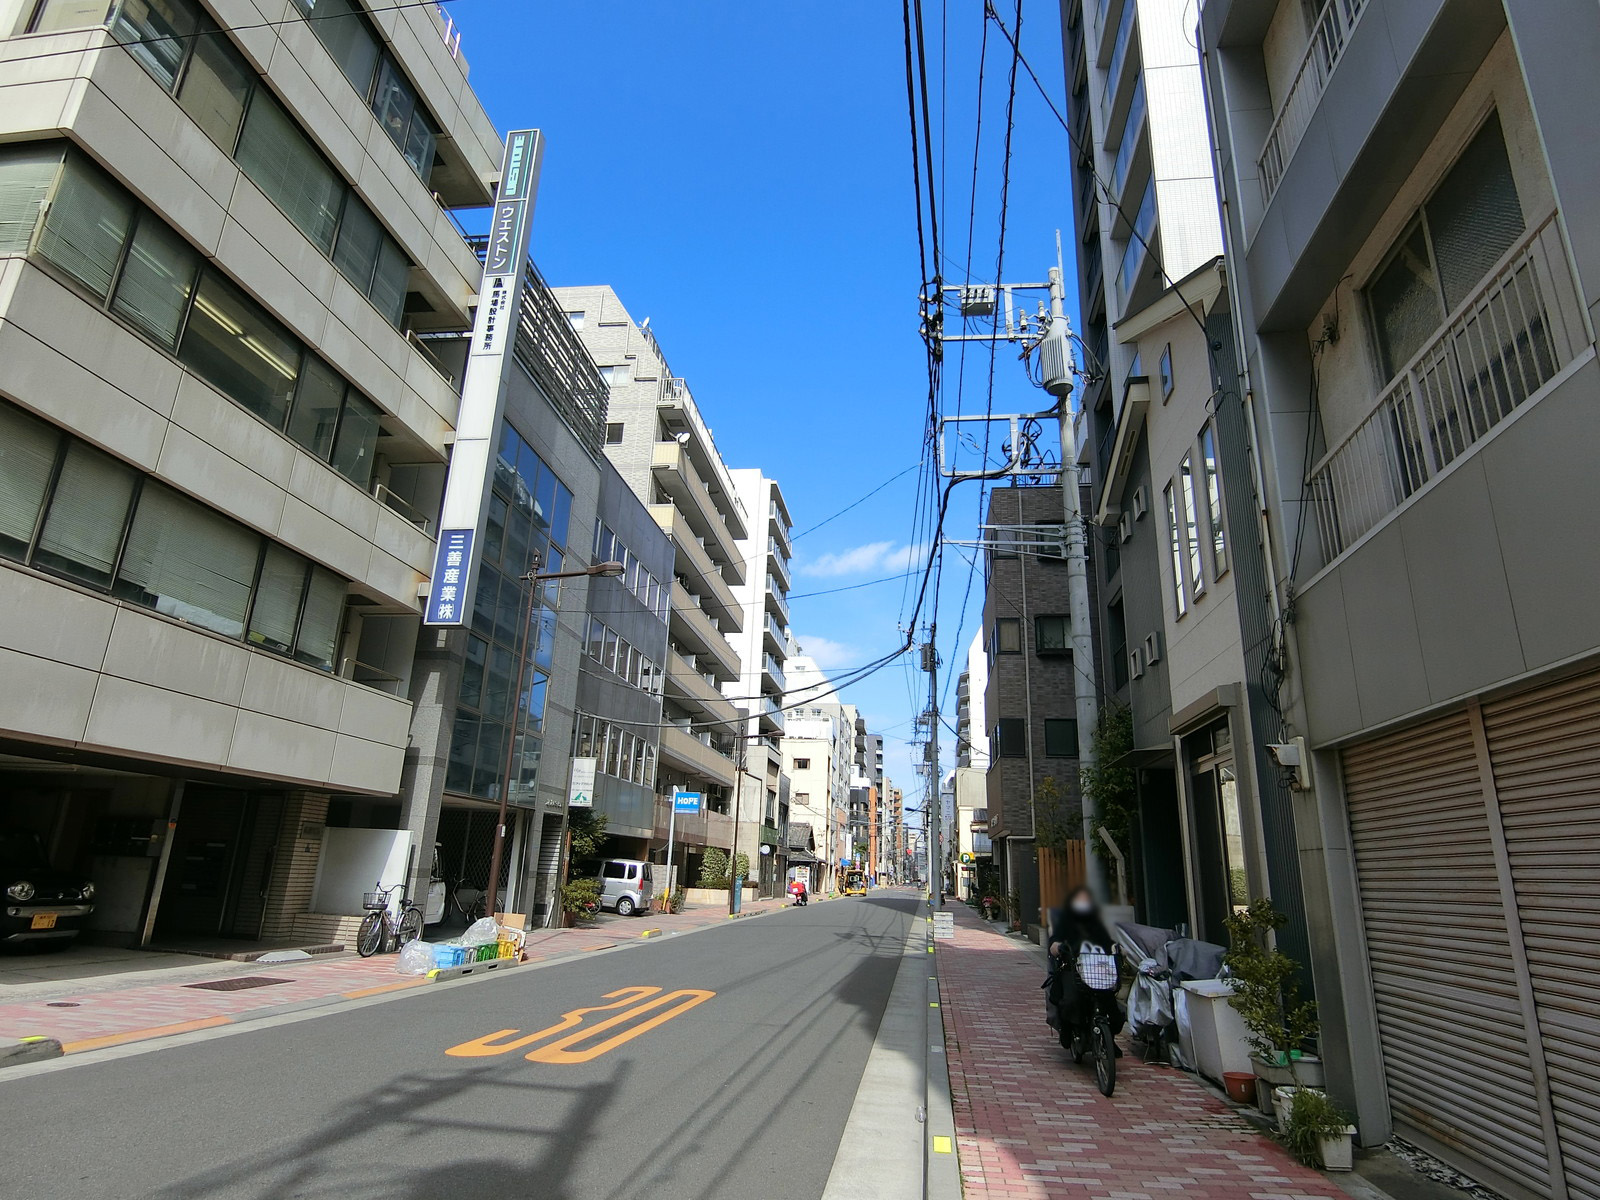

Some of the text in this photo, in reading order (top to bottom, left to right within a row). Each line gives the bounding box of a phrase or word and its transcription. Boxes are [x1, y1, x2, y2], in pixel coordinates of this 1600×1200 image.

[492, 206, 515, 269] ウエストン
[482, 290, 500, 351] 馬場設計事務所
[677, 796, 699, 805] HOPE
[963, 854, 970, 863] P
[444, 986, 717, 1064] 30
